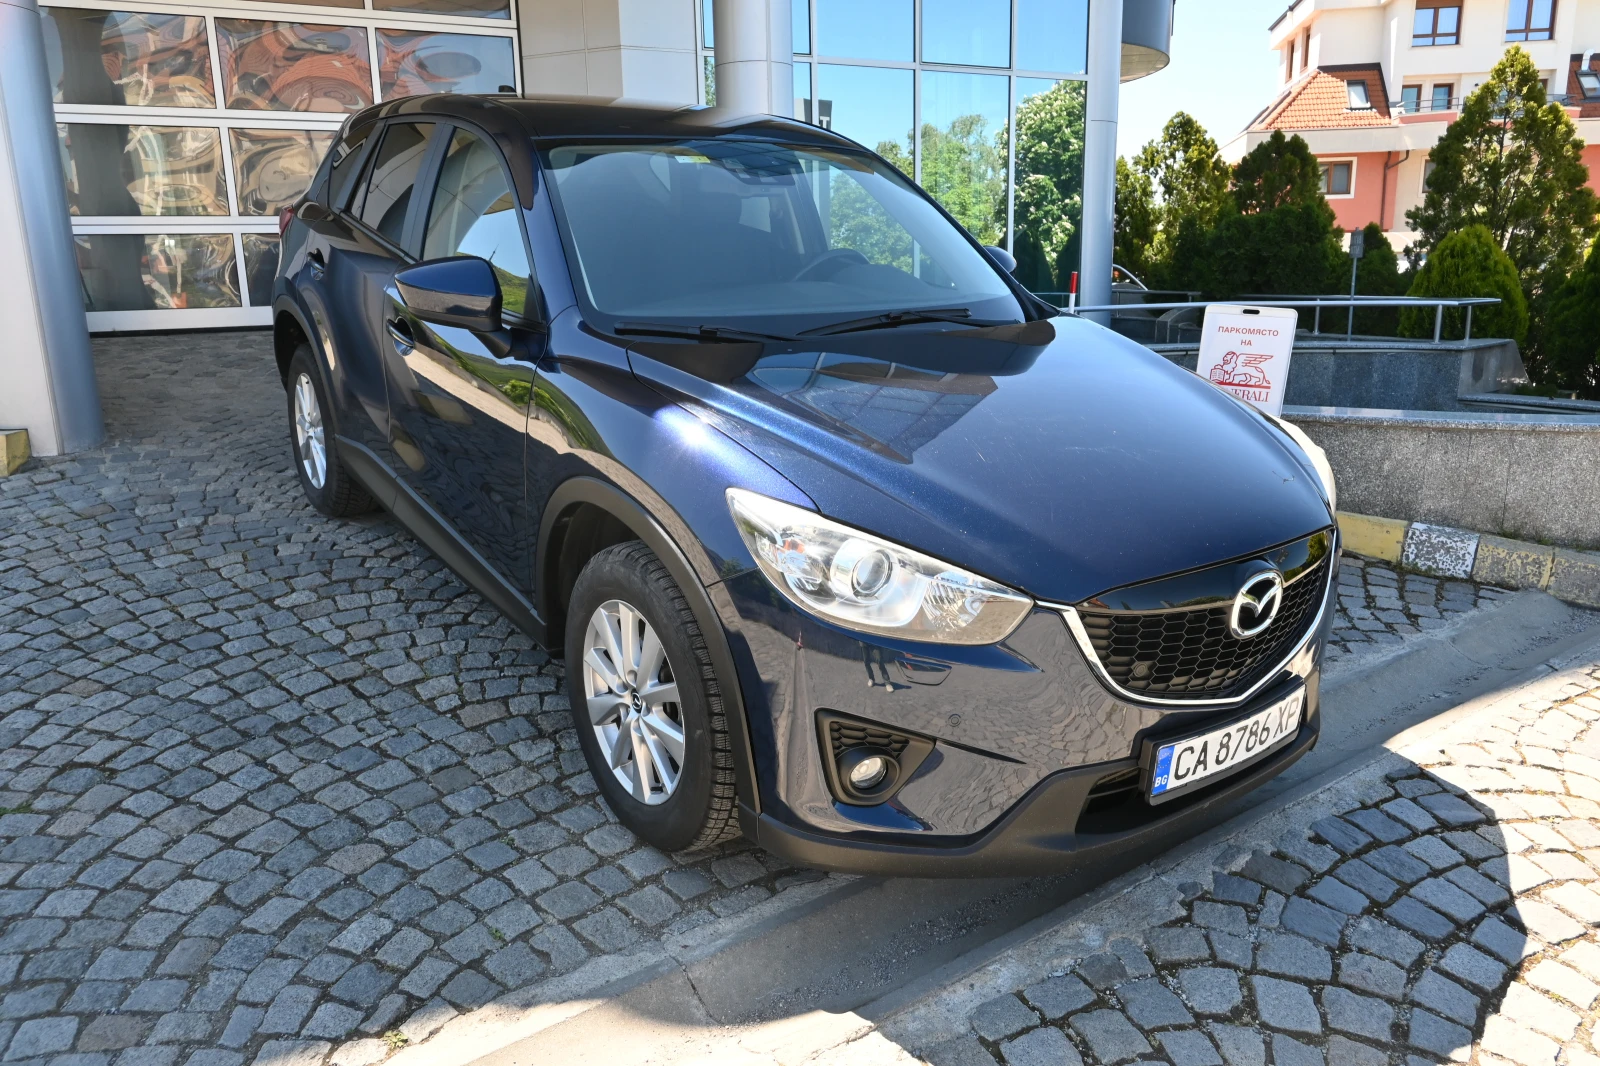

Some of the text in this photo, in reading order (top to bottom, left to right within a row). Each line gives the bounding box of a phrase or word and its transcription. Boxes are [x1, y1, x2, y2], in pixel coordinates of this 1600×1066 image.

[1218, 326, 1279, 336] ПАРКОМЯСТО
[1232, 389, 1269, 402] ERALI
[1174, 741, 1208, 781] CA
[1215, 713, 1271, 766] 8786
[1155, 775, 1168, 788] BG
